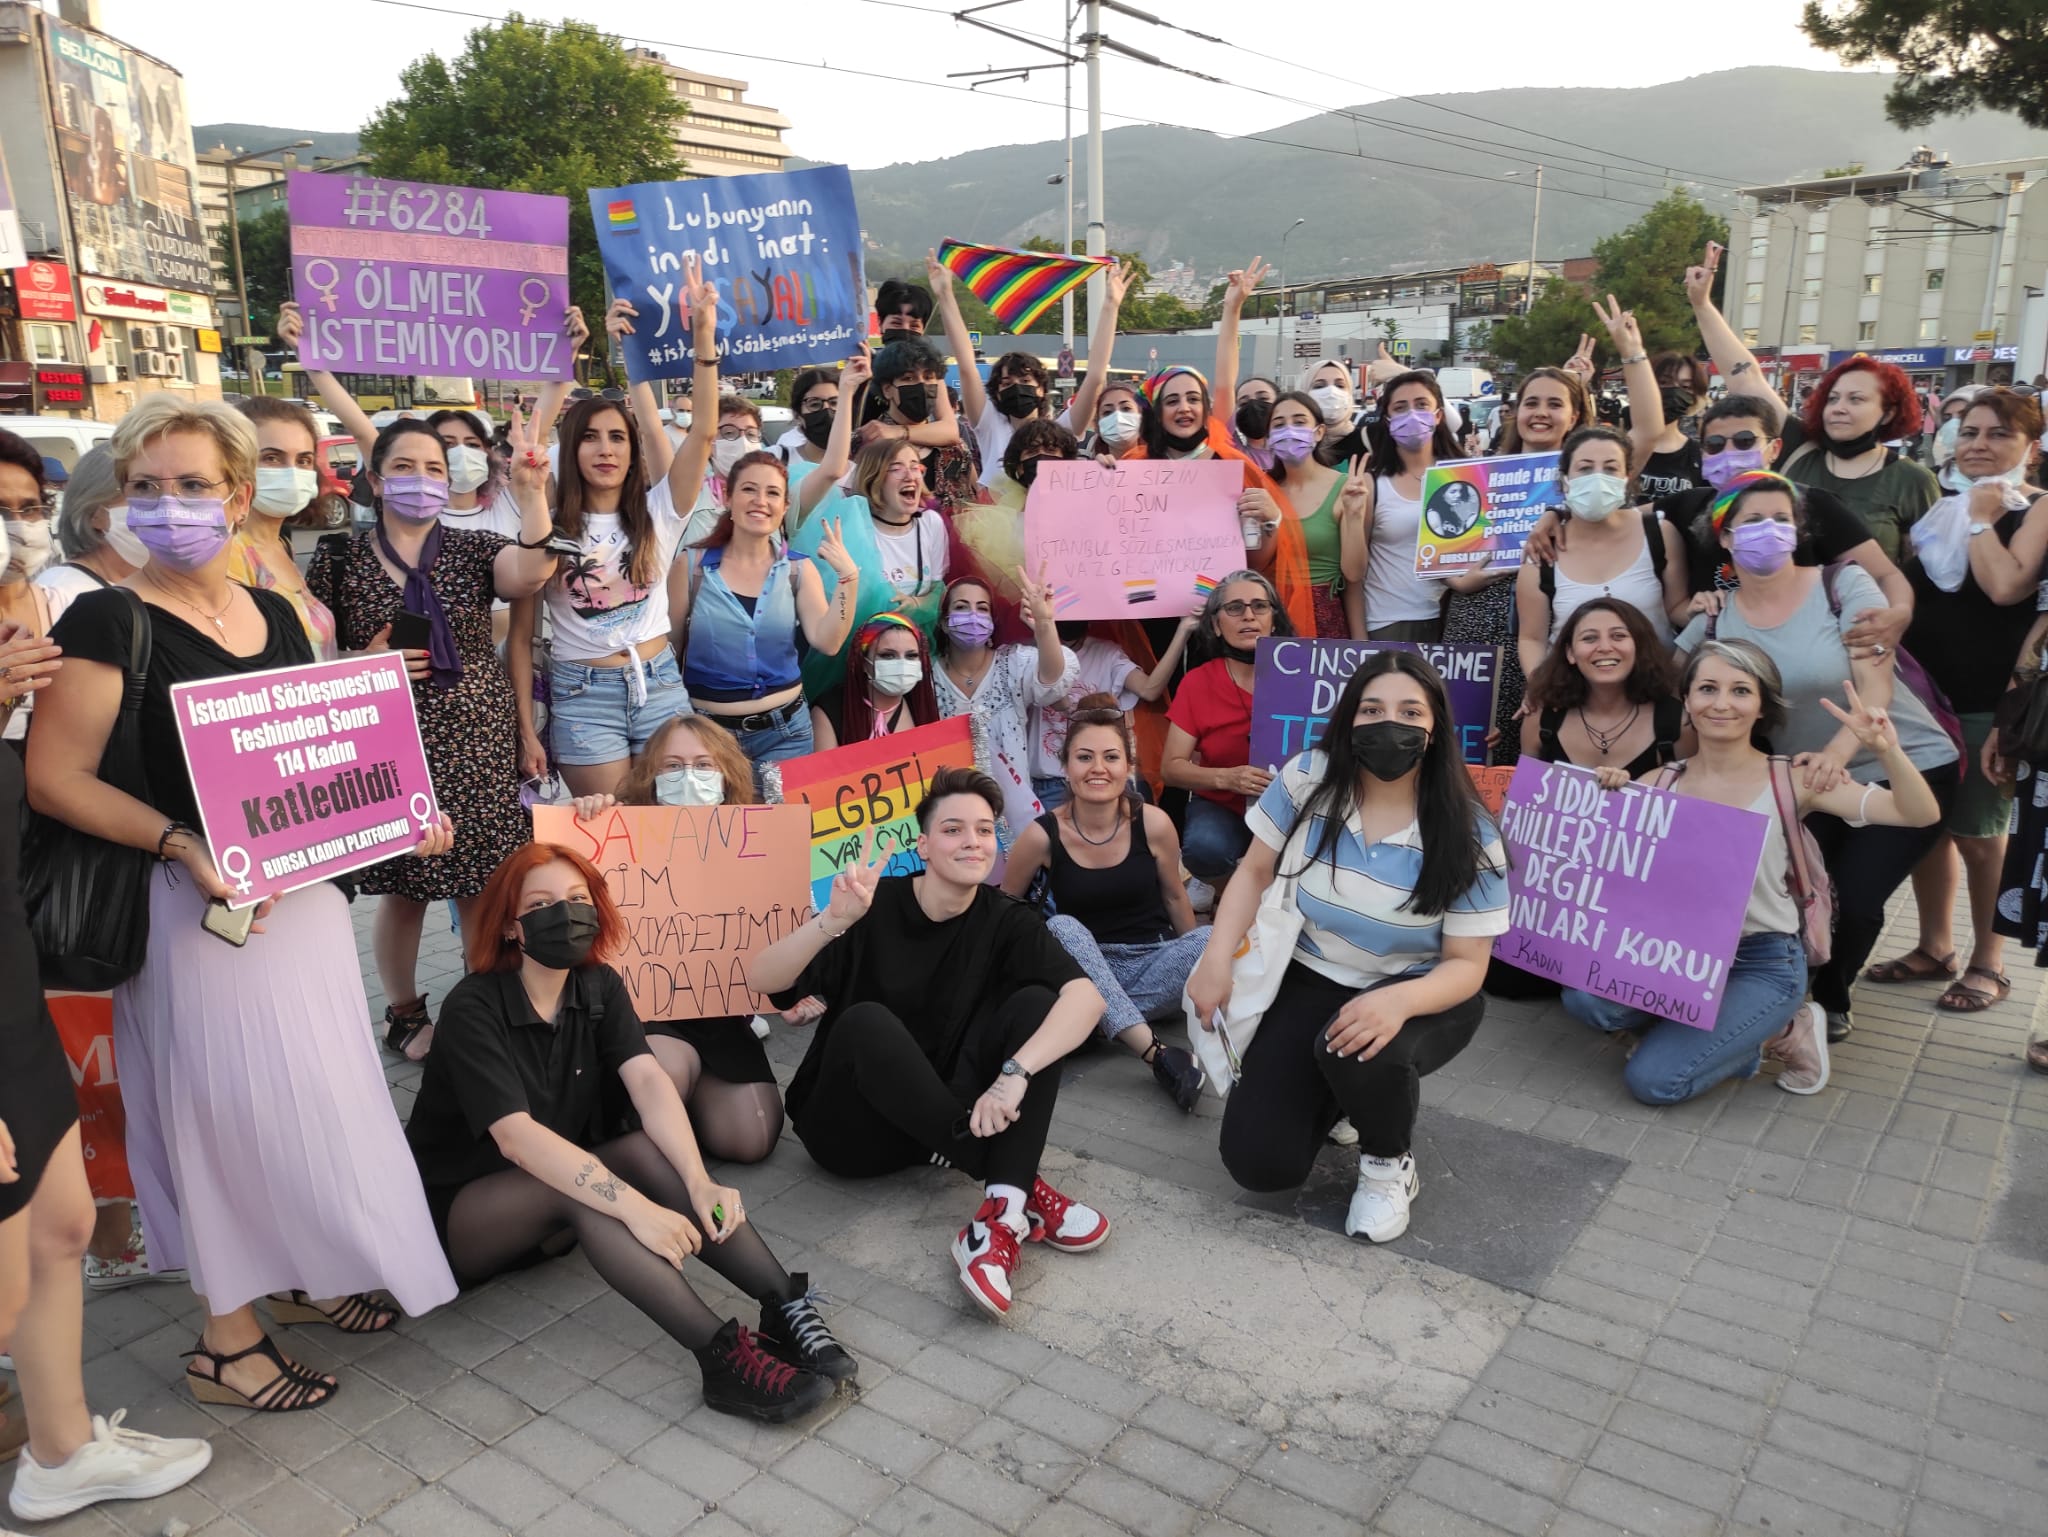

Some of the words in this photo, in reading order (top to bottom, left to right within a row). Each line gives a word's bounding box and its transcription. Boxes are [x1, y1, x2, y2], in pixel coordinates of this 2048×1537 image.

[58, 37, 123, 79] BELLONA
[344, 181, 492, 239] #6284
[665, 192, 813, 232] Lubunyanın
[354, 260, 486, 318] ÖLMEK
[308, 309, 561, 374] İSTEMİYORUZ
[1106, 493, 1168, 515] OLSUN
[1486, 490, 1527, 504] Trans
[1488, 469, 1530, 488] Hande
[1035, 534, 1112, 560] İSTANBUL
[186, 687, 273, 727] İstanbul
[274, 668, 400, 707] Sözleşmesi'nin
[230, 715, 329, 754] Feshinden
[329, 704, 381, 733] Sonra
[273, 745, 305, 778] 114
[305, 740, 358, 770] Kadın
[241, 760, 403, 839] Katledildi!
[261, 853, 308, 880] BURSA
[308, 836, 346, 866] KADIN
[347, 817, 411, 854] PLATFORMU
[819, 834, 863, 870] VAR
[1524, 852, 1608, 913] DEĞİL
[1511, 935, 1563, 975] KADIN
[1586, 960, 1701, 1023] PLATFORMU
[1615, 927, 1723, 1001] KORU!
